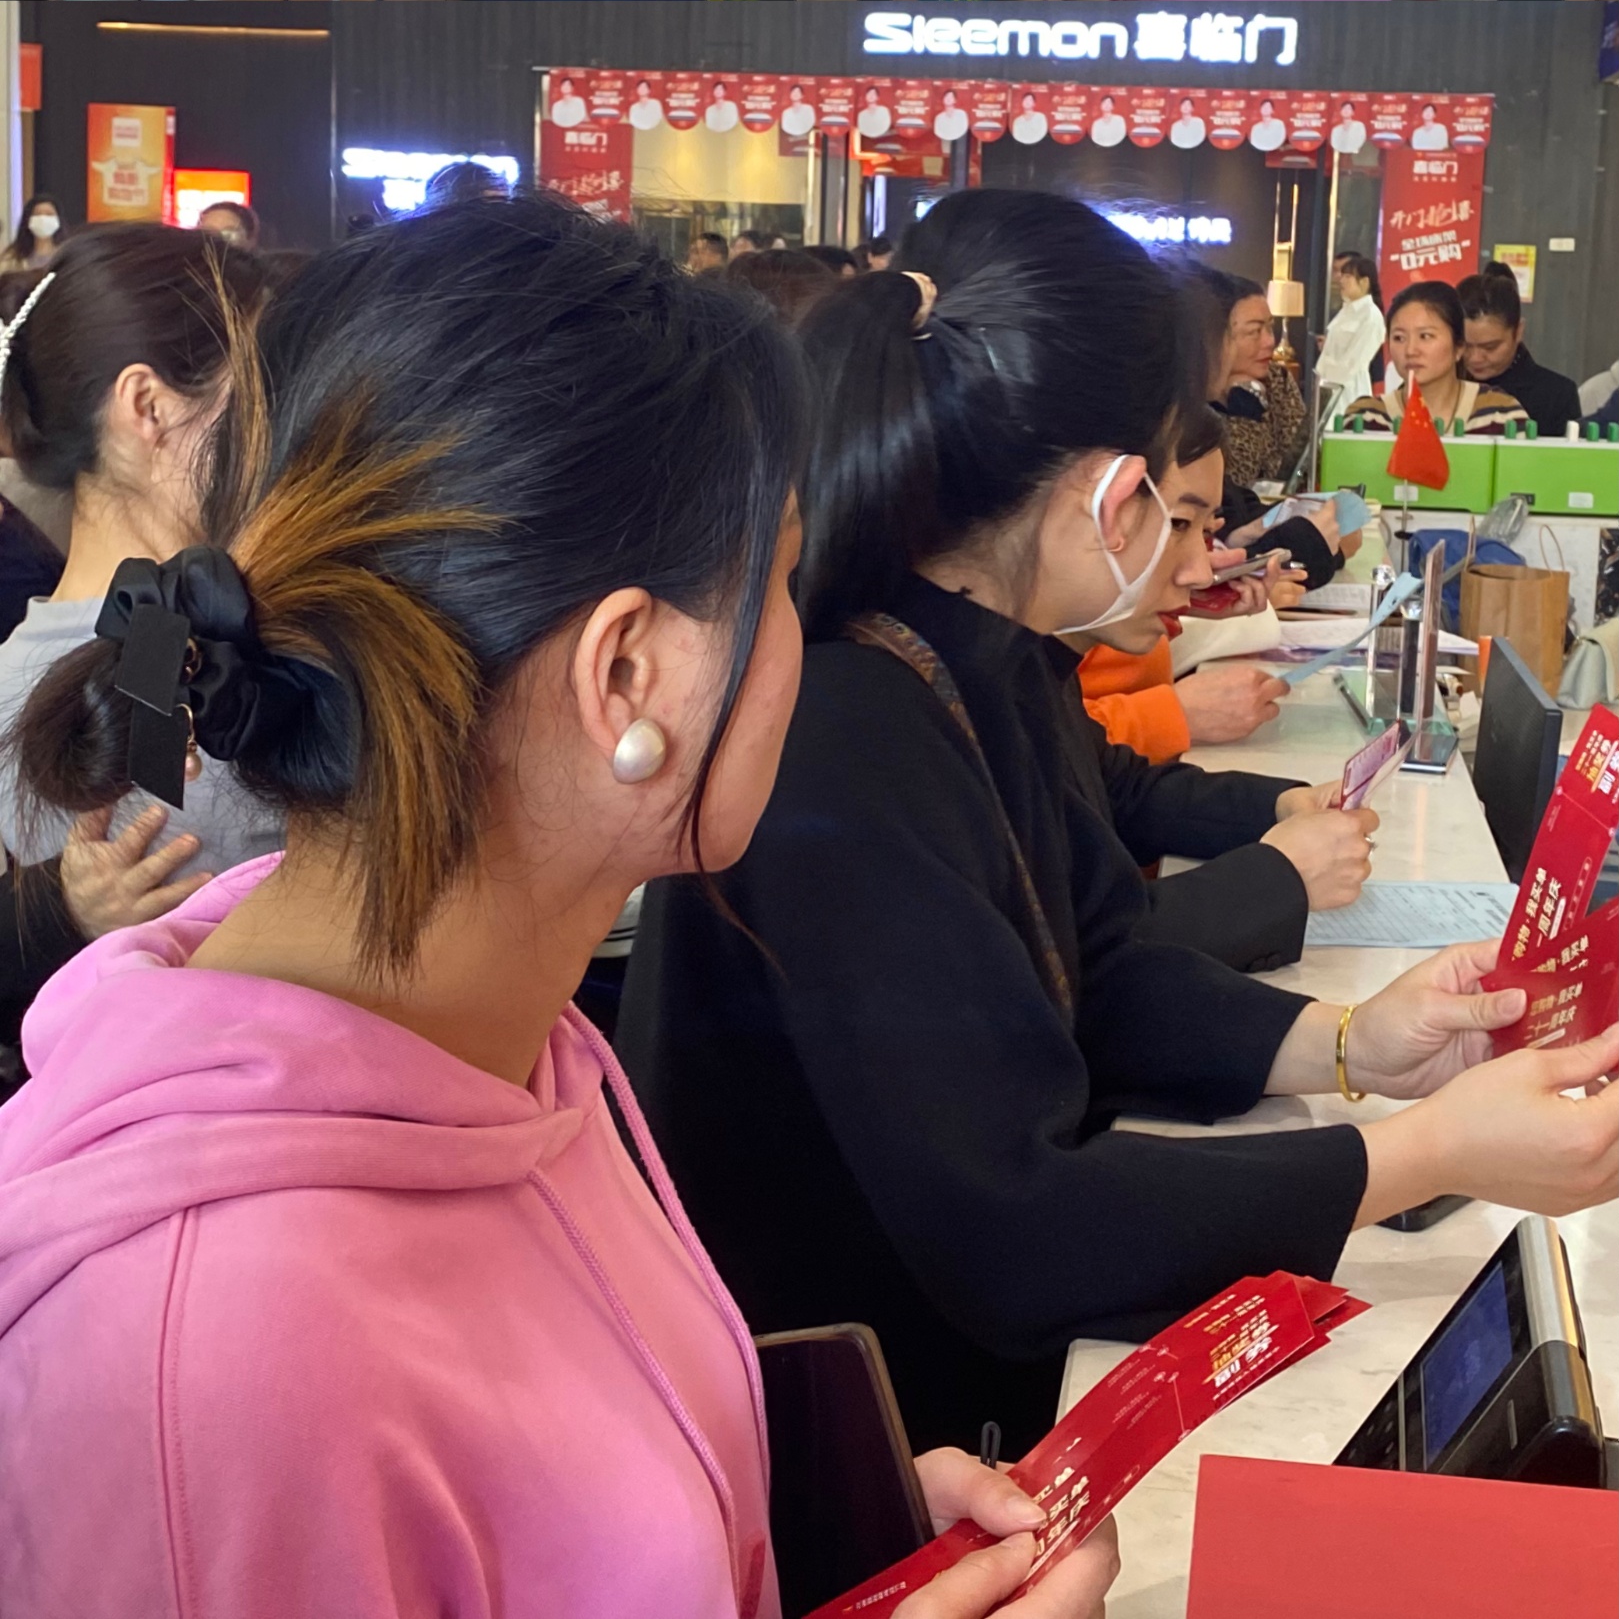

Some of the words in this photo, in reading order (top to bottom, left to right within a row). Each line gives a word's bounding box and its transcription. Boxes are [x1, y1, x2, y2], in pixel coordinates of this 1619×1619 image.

[1133, 11, 1300, 67] 喜临门
[1511, 867, 1548, 961] 购物·我买单
